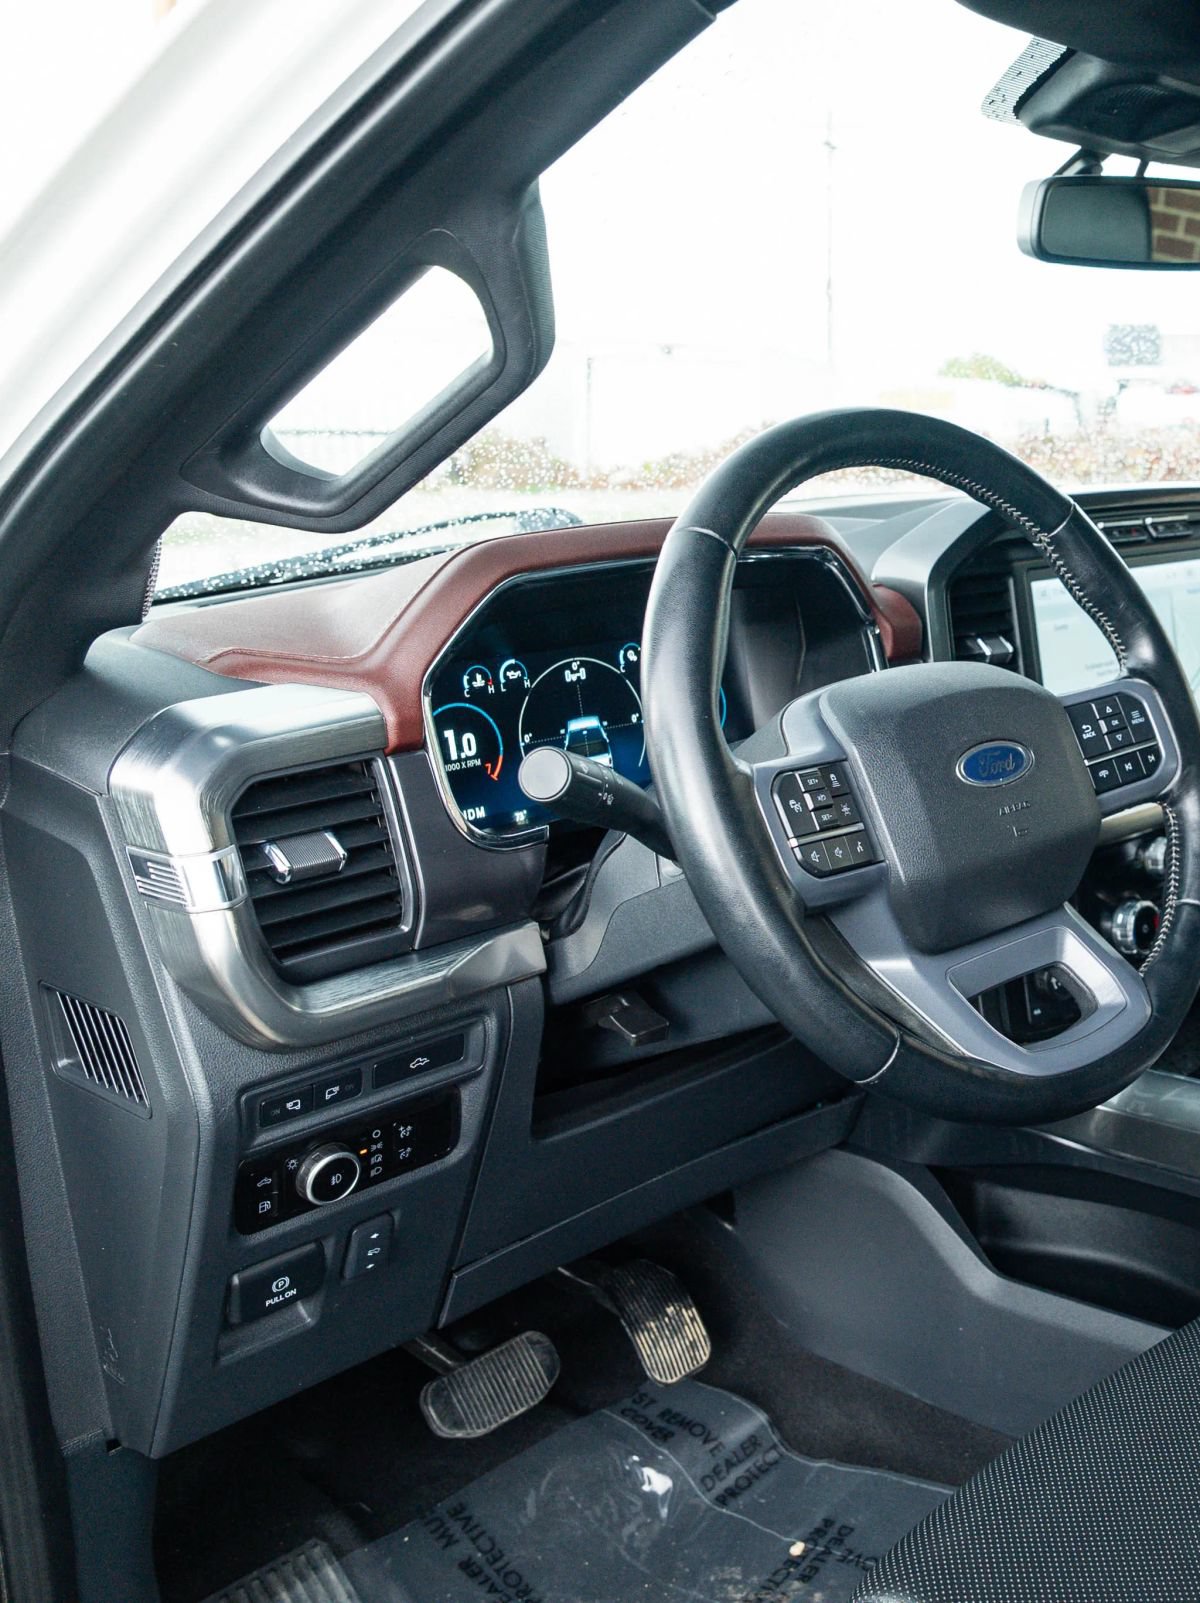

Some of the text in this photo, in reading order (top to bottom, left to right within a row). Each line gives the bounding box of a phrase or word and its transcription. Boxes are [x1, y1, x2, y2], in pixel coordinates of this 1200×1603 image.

[488, 685, 495, 694] H
[501, 683, 506, 692] L
[524, 680, 531, 689] H
[464, 688, 471, 697] C
[1131, 717, 1145, 725] MENU
[1082, 731, 1096, 740] BACK
[443, 729, 477, 761] 1.0
[444, 758, 482, 772] 1000 X RPM
[977, 750, 1016, 778] Ford
[265, 1288, 297, 1307] PULL ON
[656, 1408, 726, 1457] REMOVE
[700, 1434, 762, 1492] DEALER
